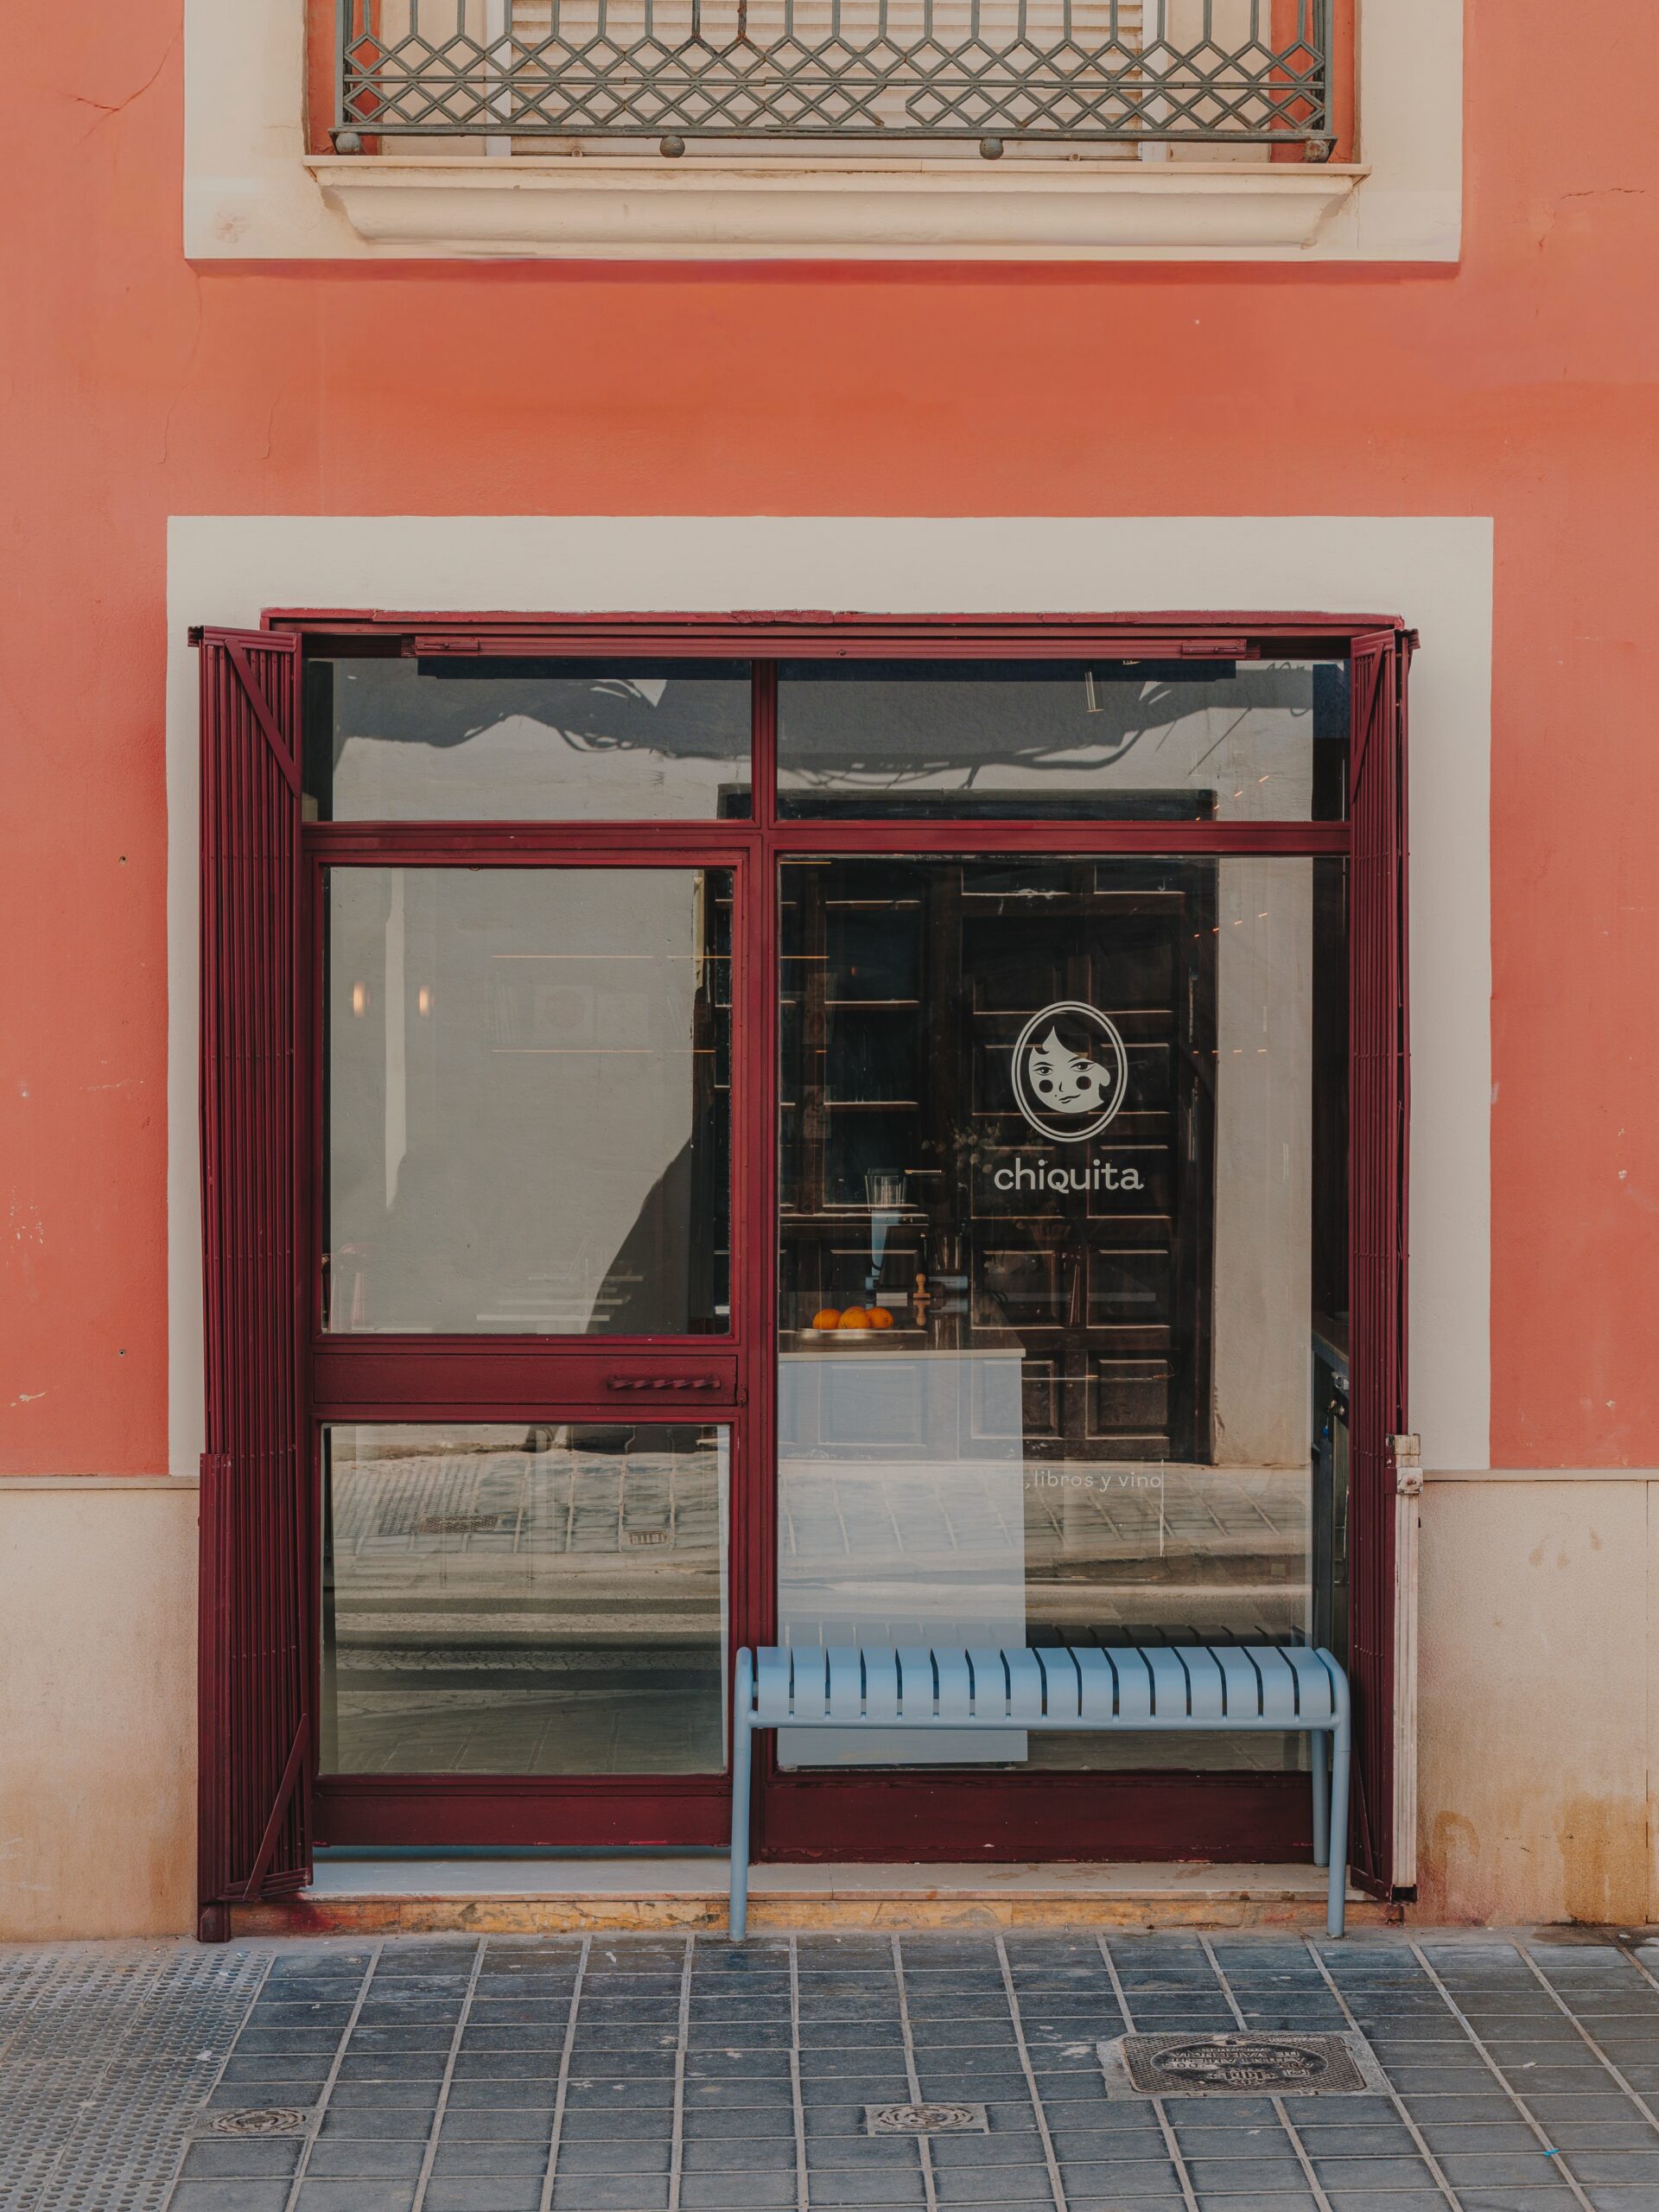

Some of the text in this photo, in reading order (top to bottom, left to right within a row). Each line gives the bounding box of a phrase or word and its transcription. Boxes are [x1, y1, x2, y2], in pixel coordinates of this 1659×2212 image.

[994, 1157, 1145, 1194] chiquita
[1034, 1470, 1094, 1487] libros
[1100, 1475, 1112, 1492] y
[1118, 1471, 1162, 1488] vino
